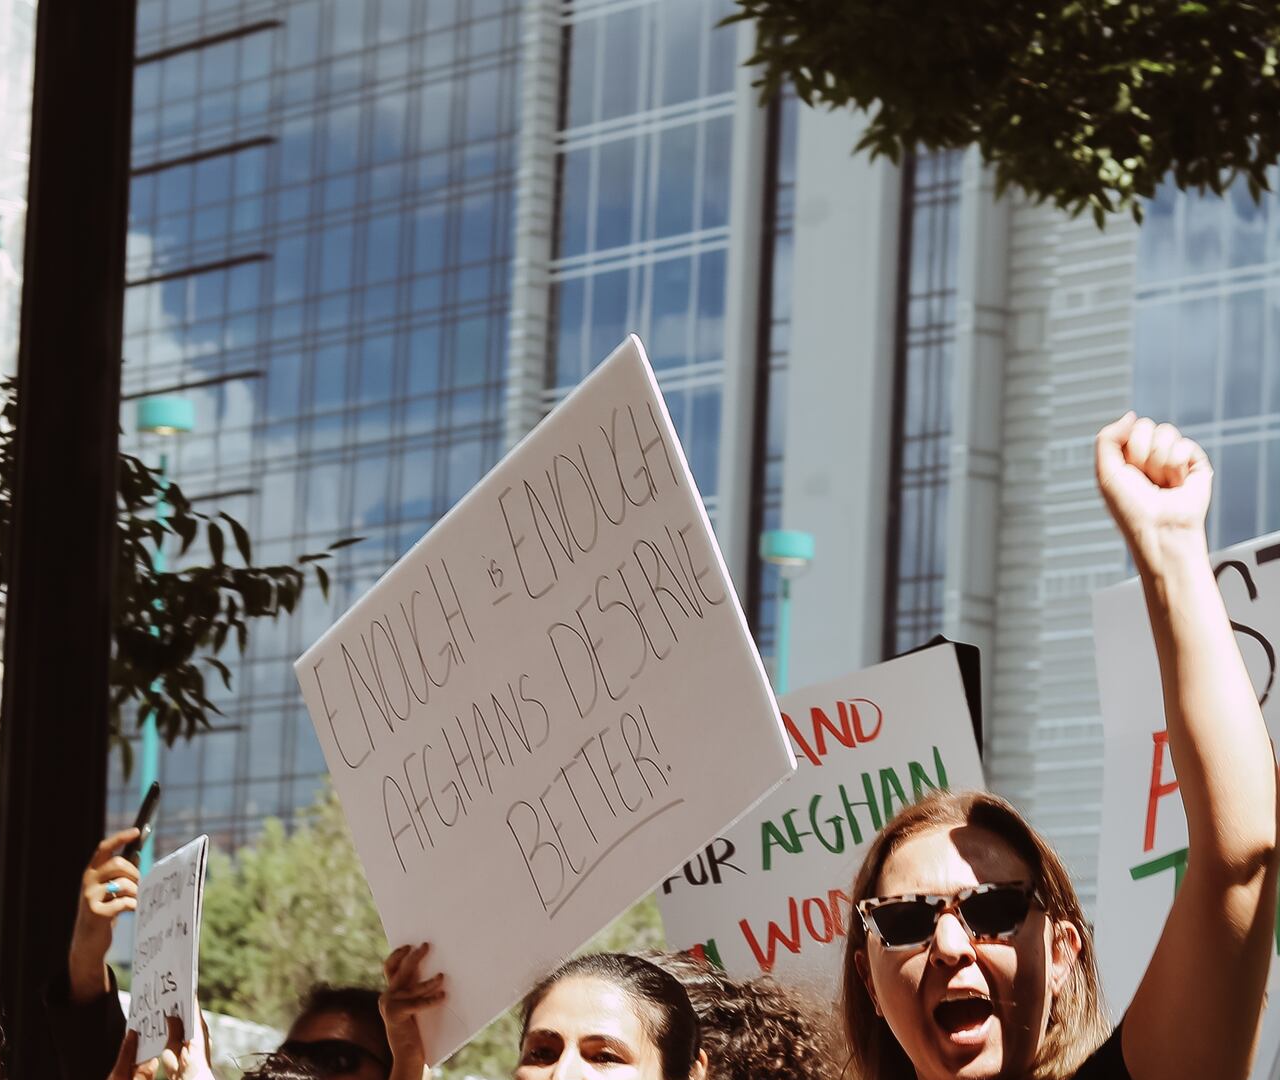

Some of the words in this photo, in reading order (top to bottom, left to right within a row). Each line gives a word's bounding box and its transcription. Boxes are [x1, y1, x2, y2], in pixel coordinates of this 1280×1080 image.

[313, 557, 477, 770] ENOUGH
[497, 400, 680, 600] ENOUGH
[380, 673, 551, 873] AFGHANS
[547, 521, 727, 719] DESERVE
[504, 703, 674, 912] BETTER!
[761, 745, 949, 871] AFGHAN
